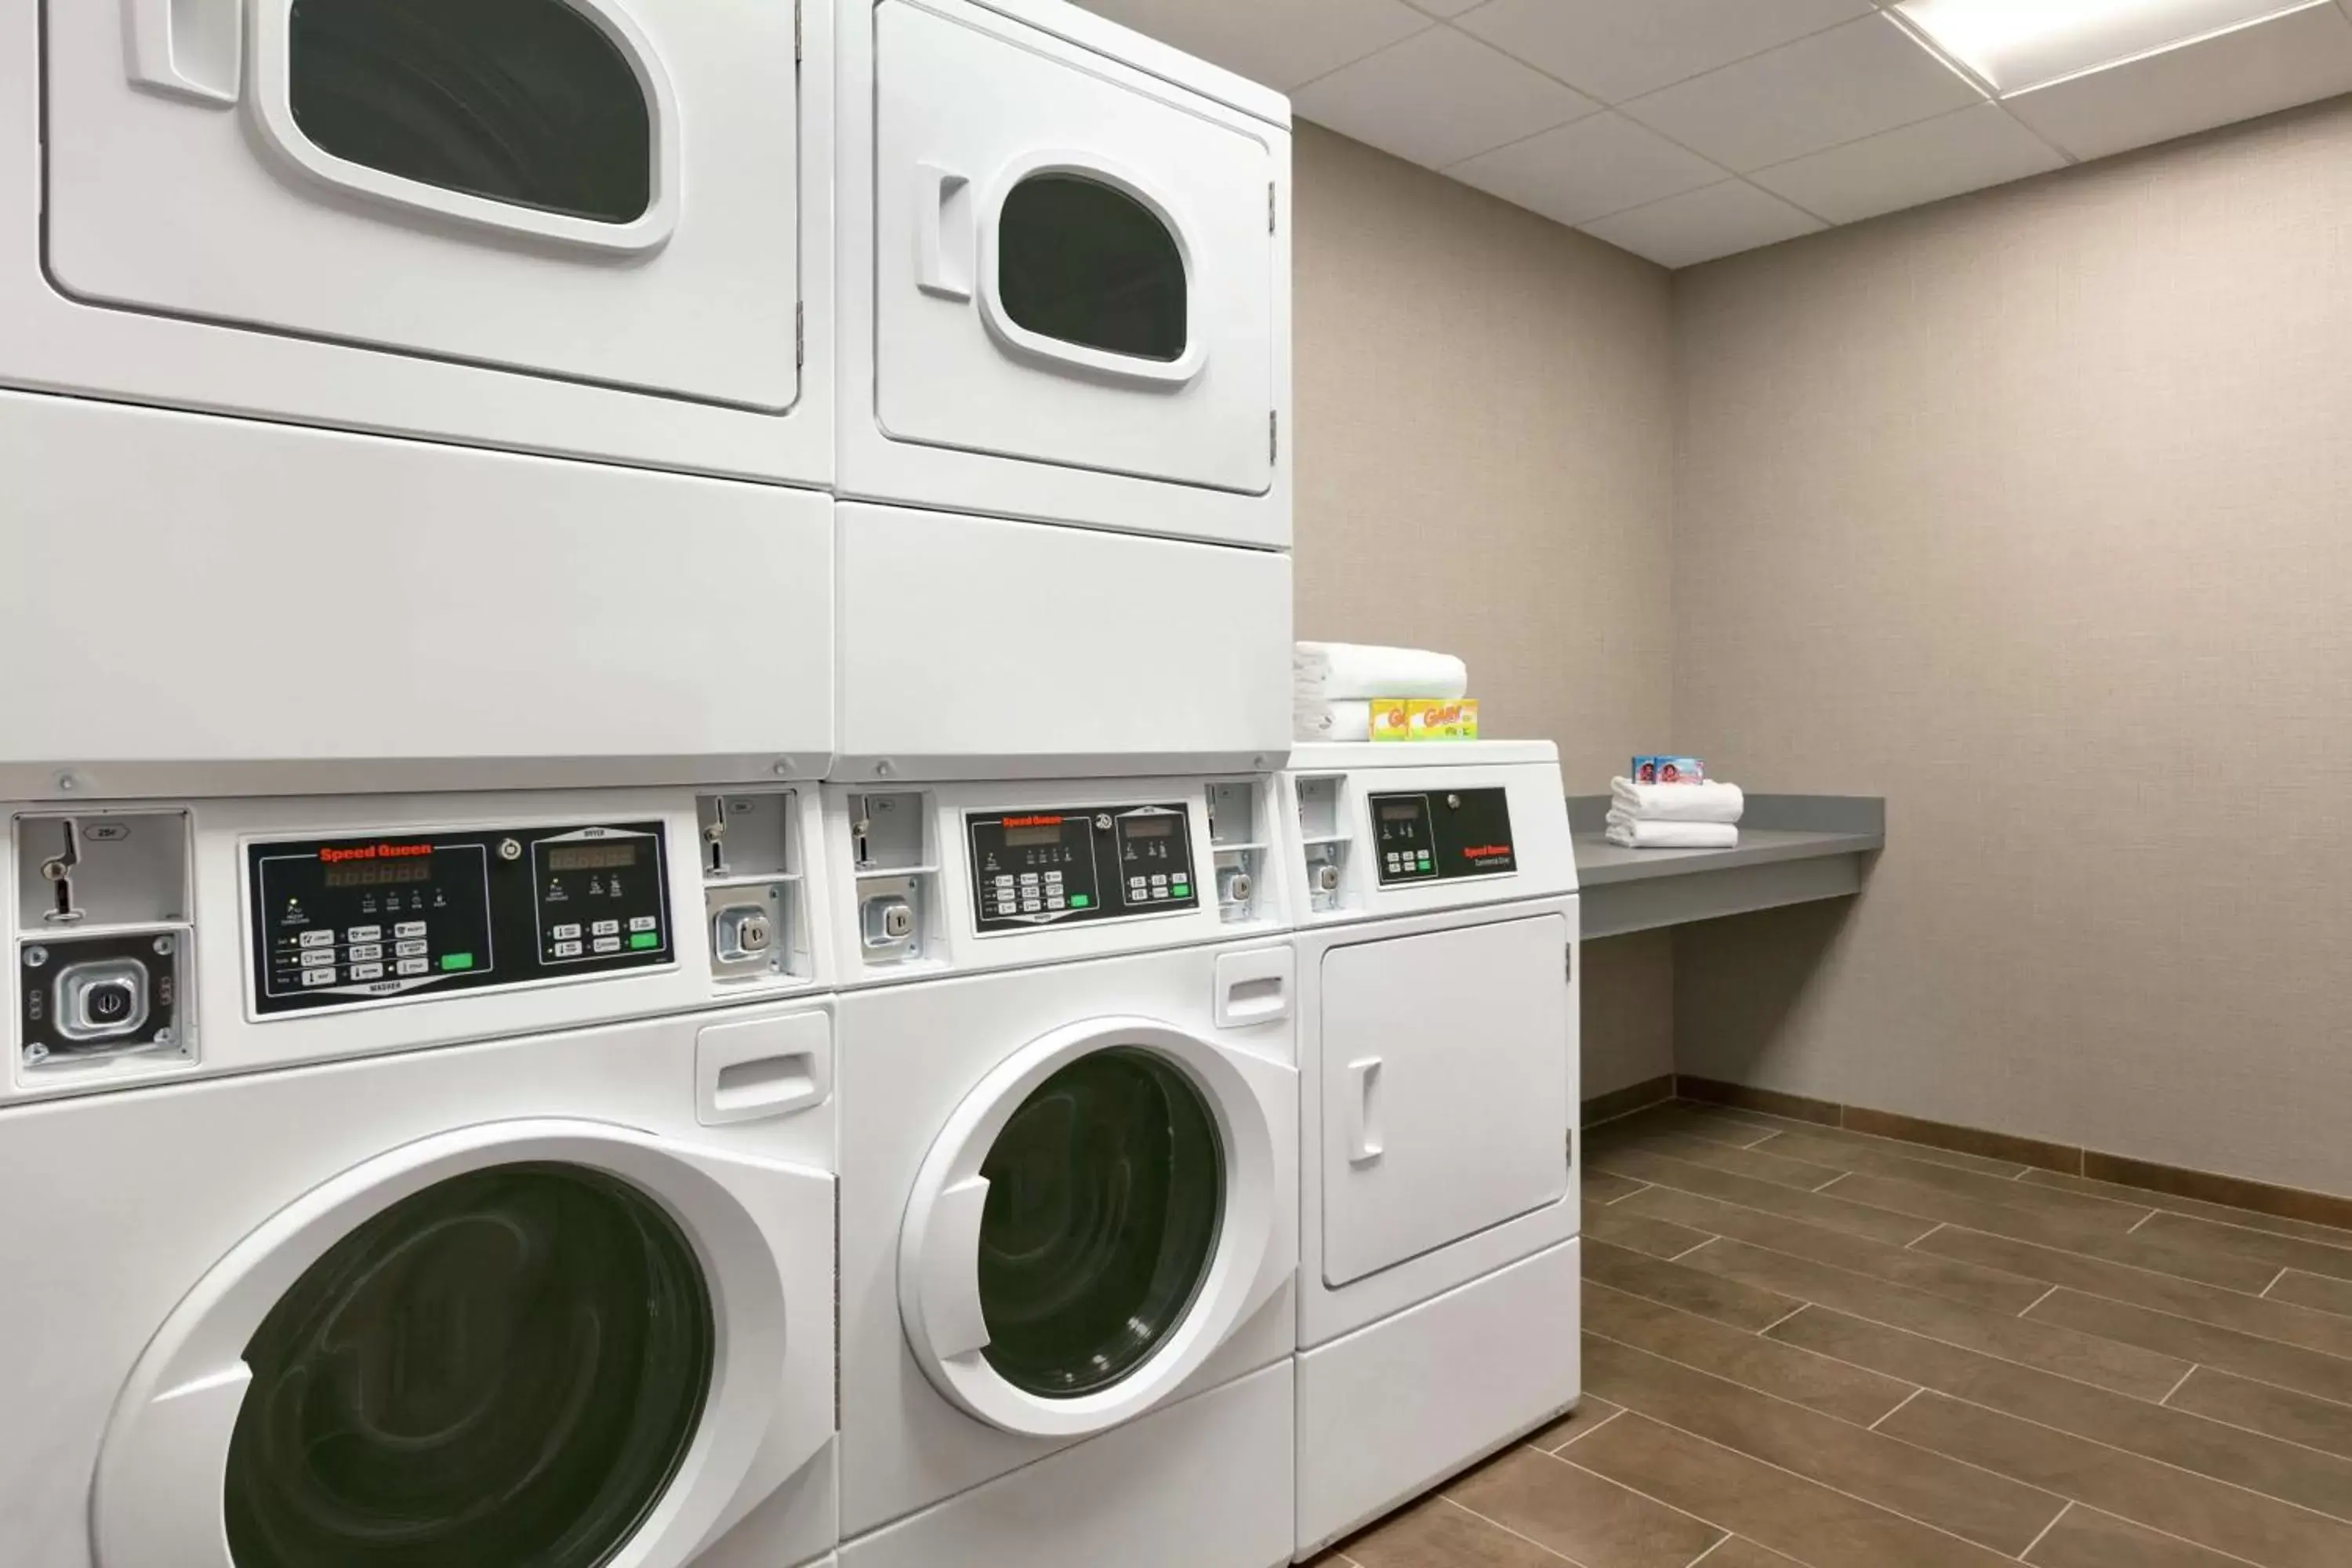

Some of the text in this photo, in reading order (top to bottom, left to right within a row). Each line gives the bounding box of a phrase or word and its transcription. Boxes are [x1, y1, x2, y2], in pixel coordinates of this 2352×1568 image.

[320, 844, 432, 862] Speed Queen
[369, 981, 401, 992] WASHER
